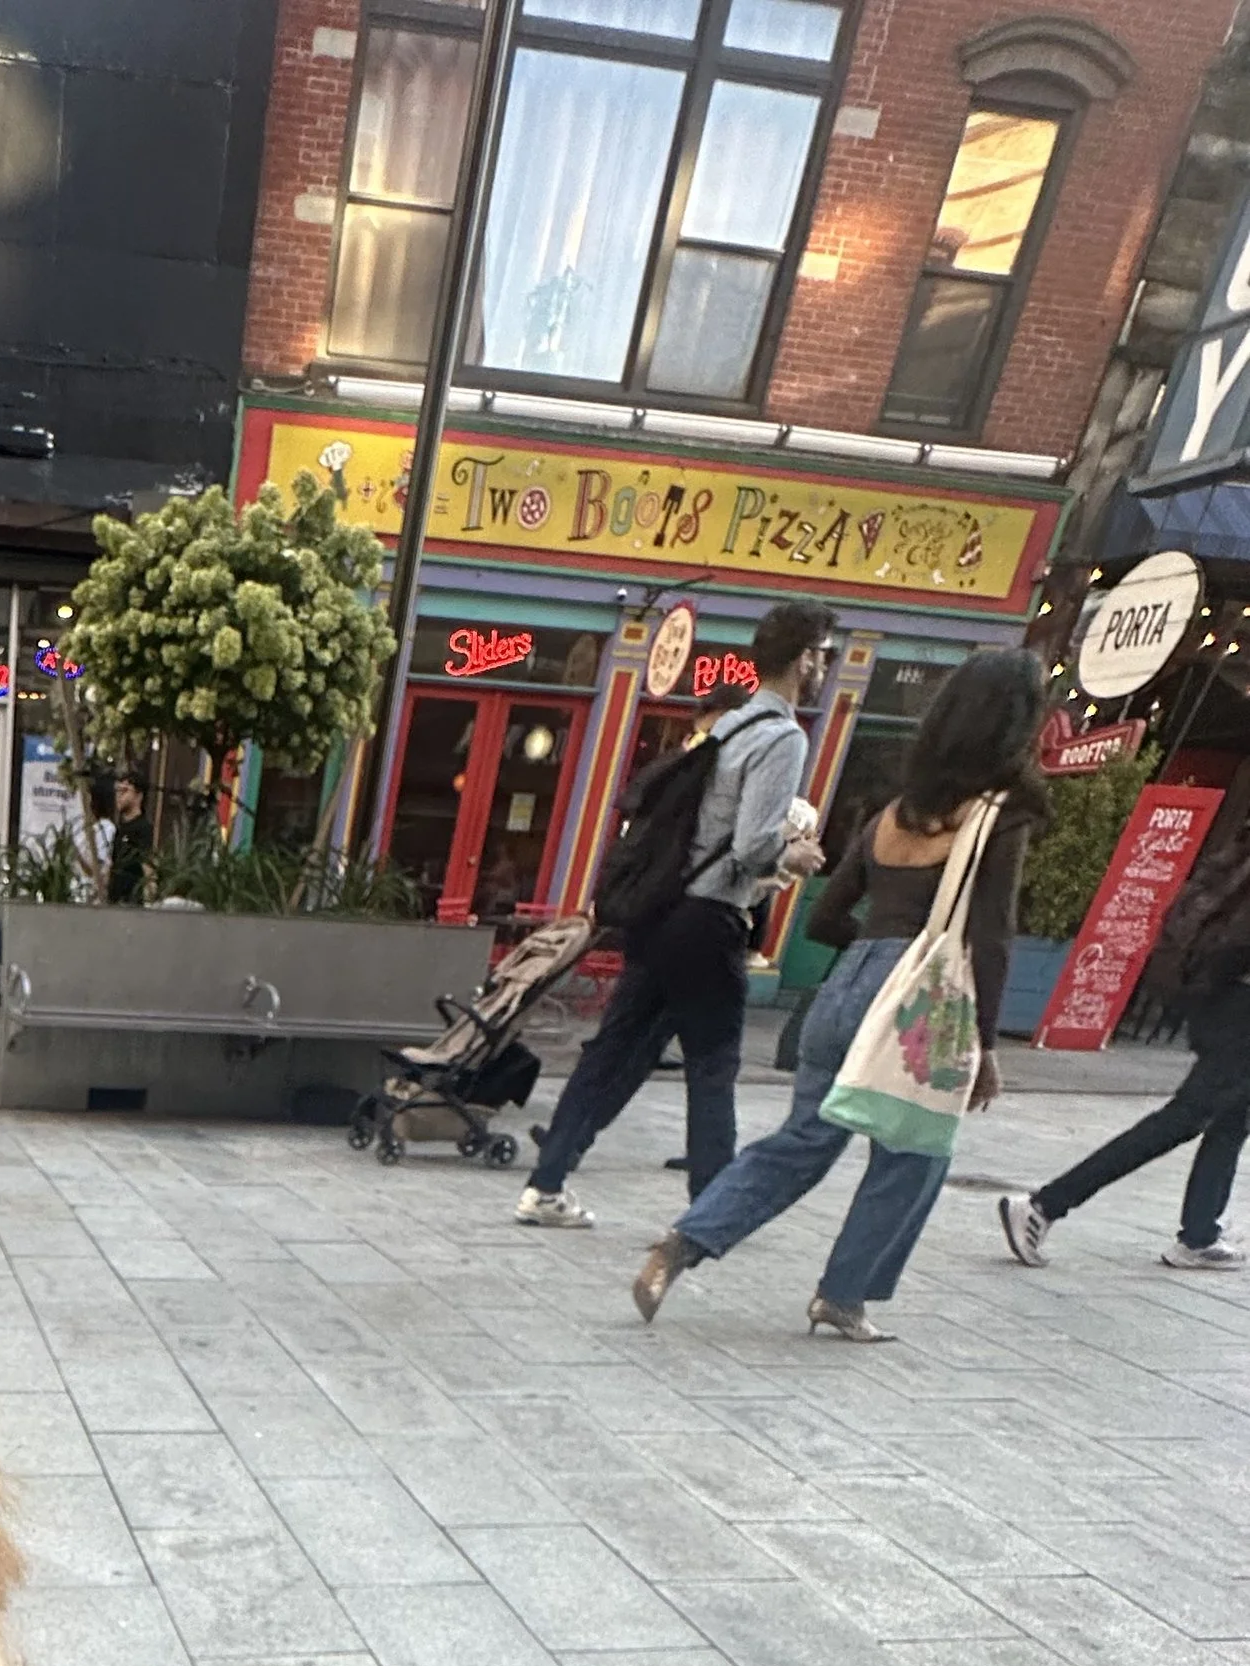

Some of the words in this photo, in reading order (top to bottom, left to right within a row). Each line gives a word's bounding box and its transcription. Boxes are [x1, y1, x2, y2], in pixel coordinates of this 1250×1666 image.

[1099, 601, 1173, 653] PORTA
[445, 629, 533, 677] Sliders
[1148, 807, 1194, 831] PORTA
